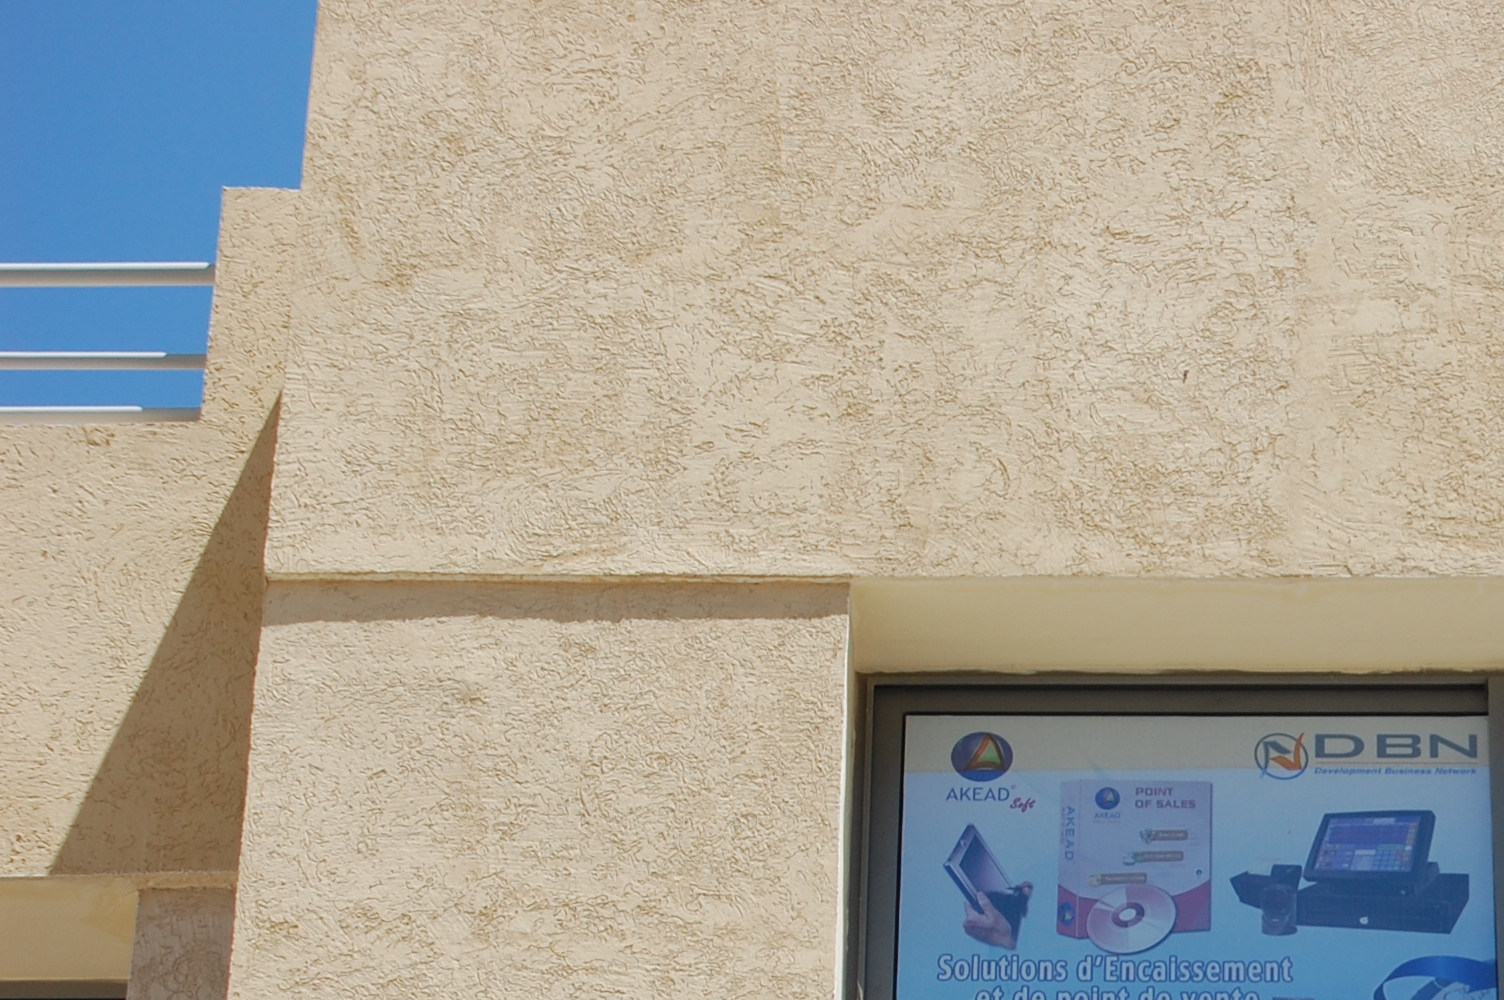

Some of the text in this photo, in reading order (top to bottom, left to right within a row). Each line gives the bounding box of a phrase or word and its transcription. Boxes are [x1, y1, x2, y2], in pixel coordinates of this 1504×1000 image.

[1315, 734, 1478, 758] DBN
[1314, 767, 1477, 776] Development Business Network
[1135, 787, 1174, 797] POINT
[1009, 797, 1036, 812] Soft
[1135, 799, 1196, 809] OF SALES
[937, 953, 1294, 983] Solutions d'Encaissement
